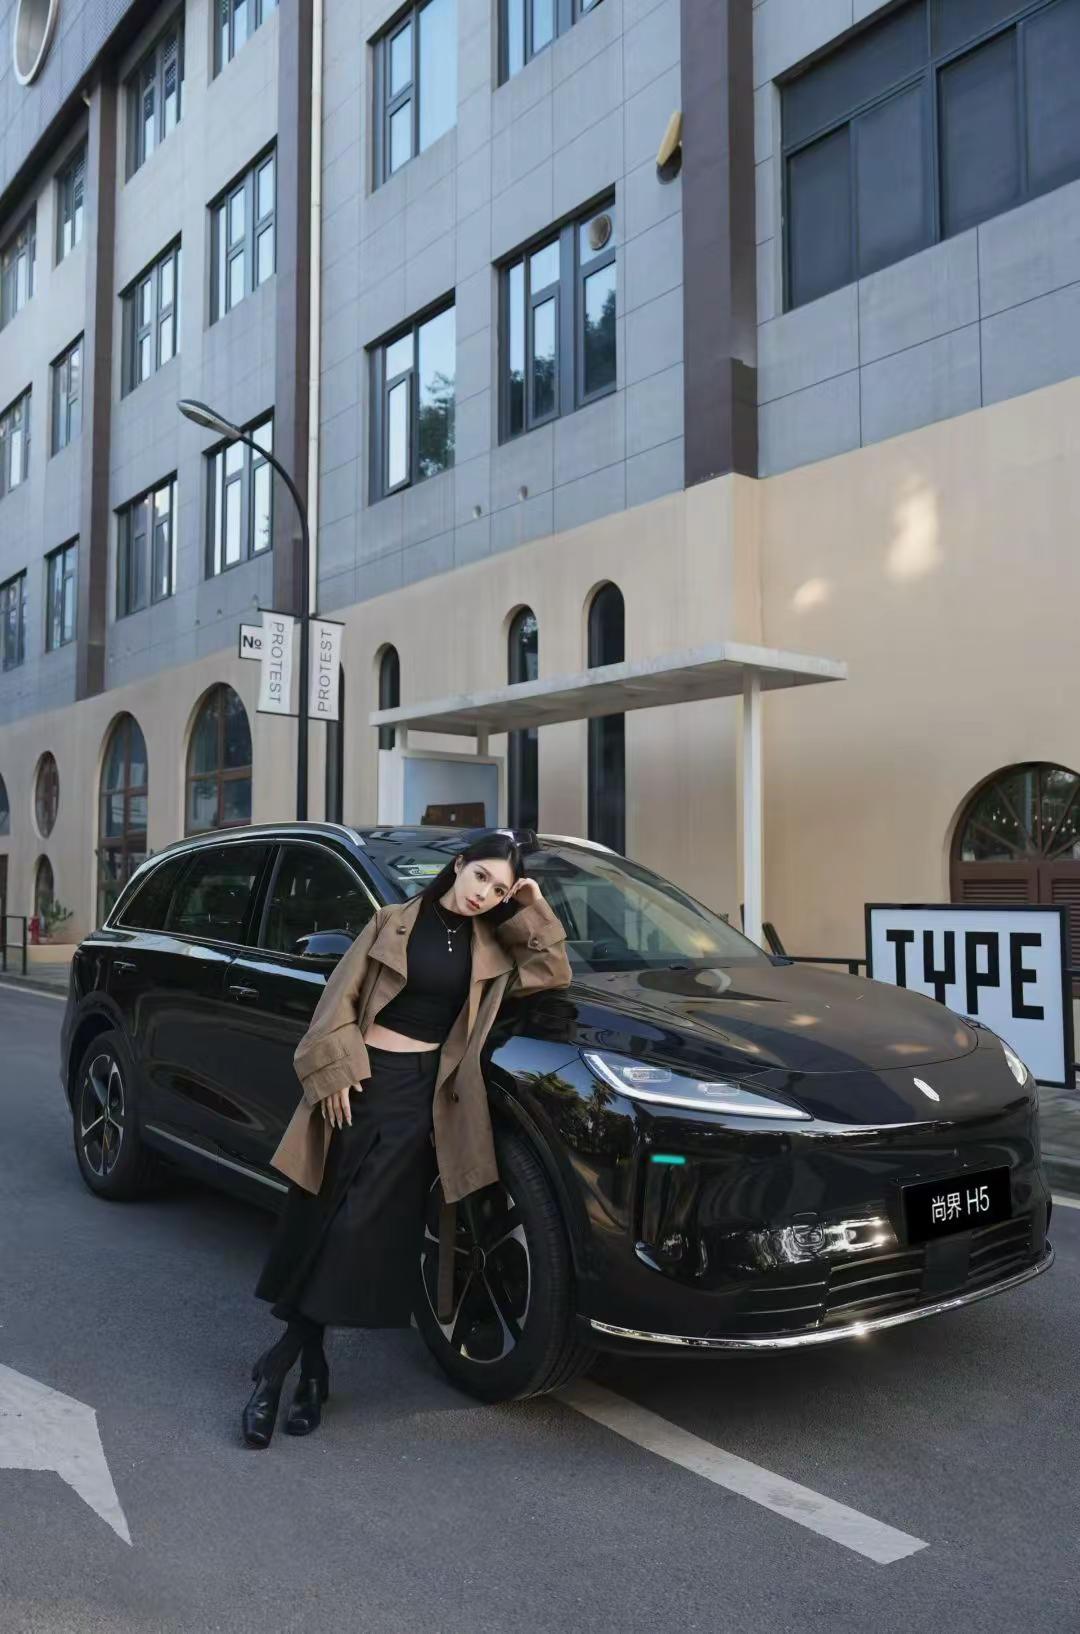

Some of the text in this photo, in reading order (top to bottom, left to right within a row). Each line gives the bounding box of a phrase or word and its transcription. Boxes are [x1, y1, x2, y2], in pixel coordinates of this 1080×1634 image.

[269, 621, 284, 704] PROTEST
[318, 629, 333, 712] PROTEST
[886, 929, 1044, 1020] TYPE
[932, 1185, 990, 1223] 尚界 H5
